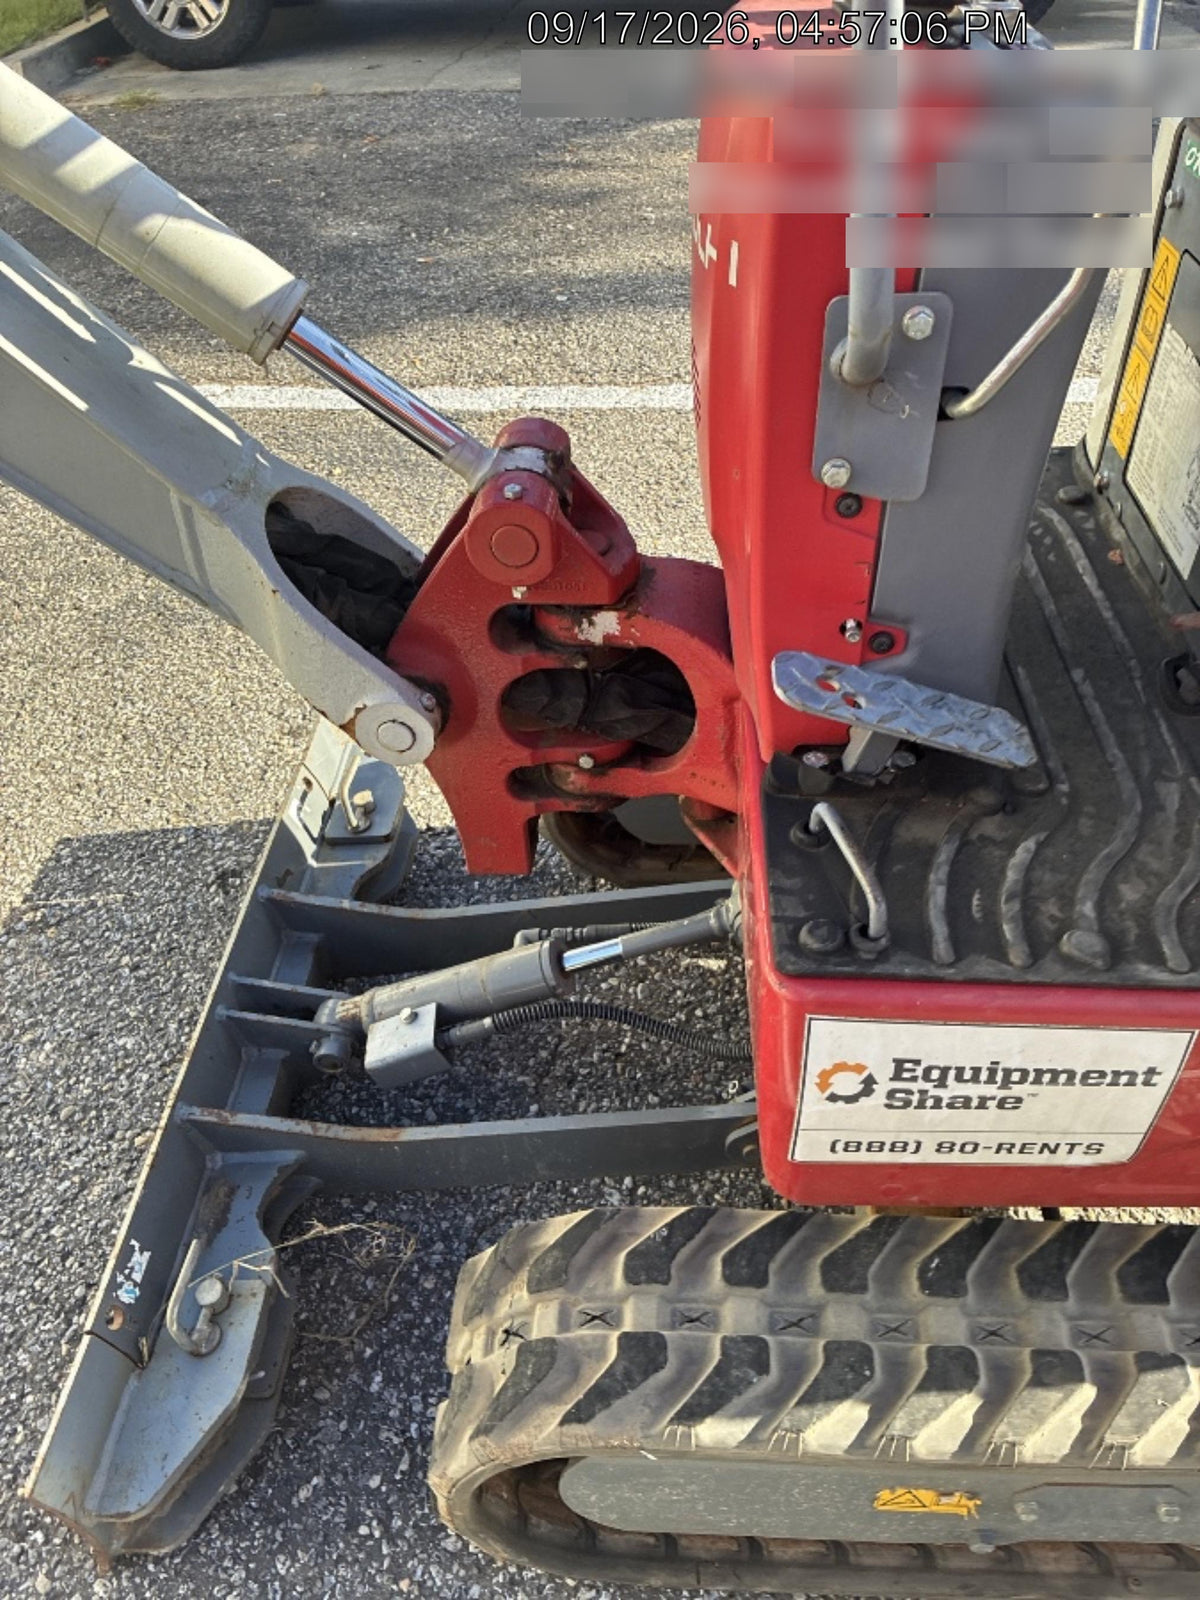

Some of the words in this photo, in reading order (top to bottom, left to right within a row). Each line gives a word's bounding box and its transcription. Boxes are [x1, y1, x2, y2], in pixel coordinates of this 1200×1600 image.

[888, 1057, 1163, 1089] Equipment
[883, 1088, 1024, 1111] Share
[829, 1139, 922, 1156] (888)
[934, 1140, 1105, 1156] 80-RENTS
